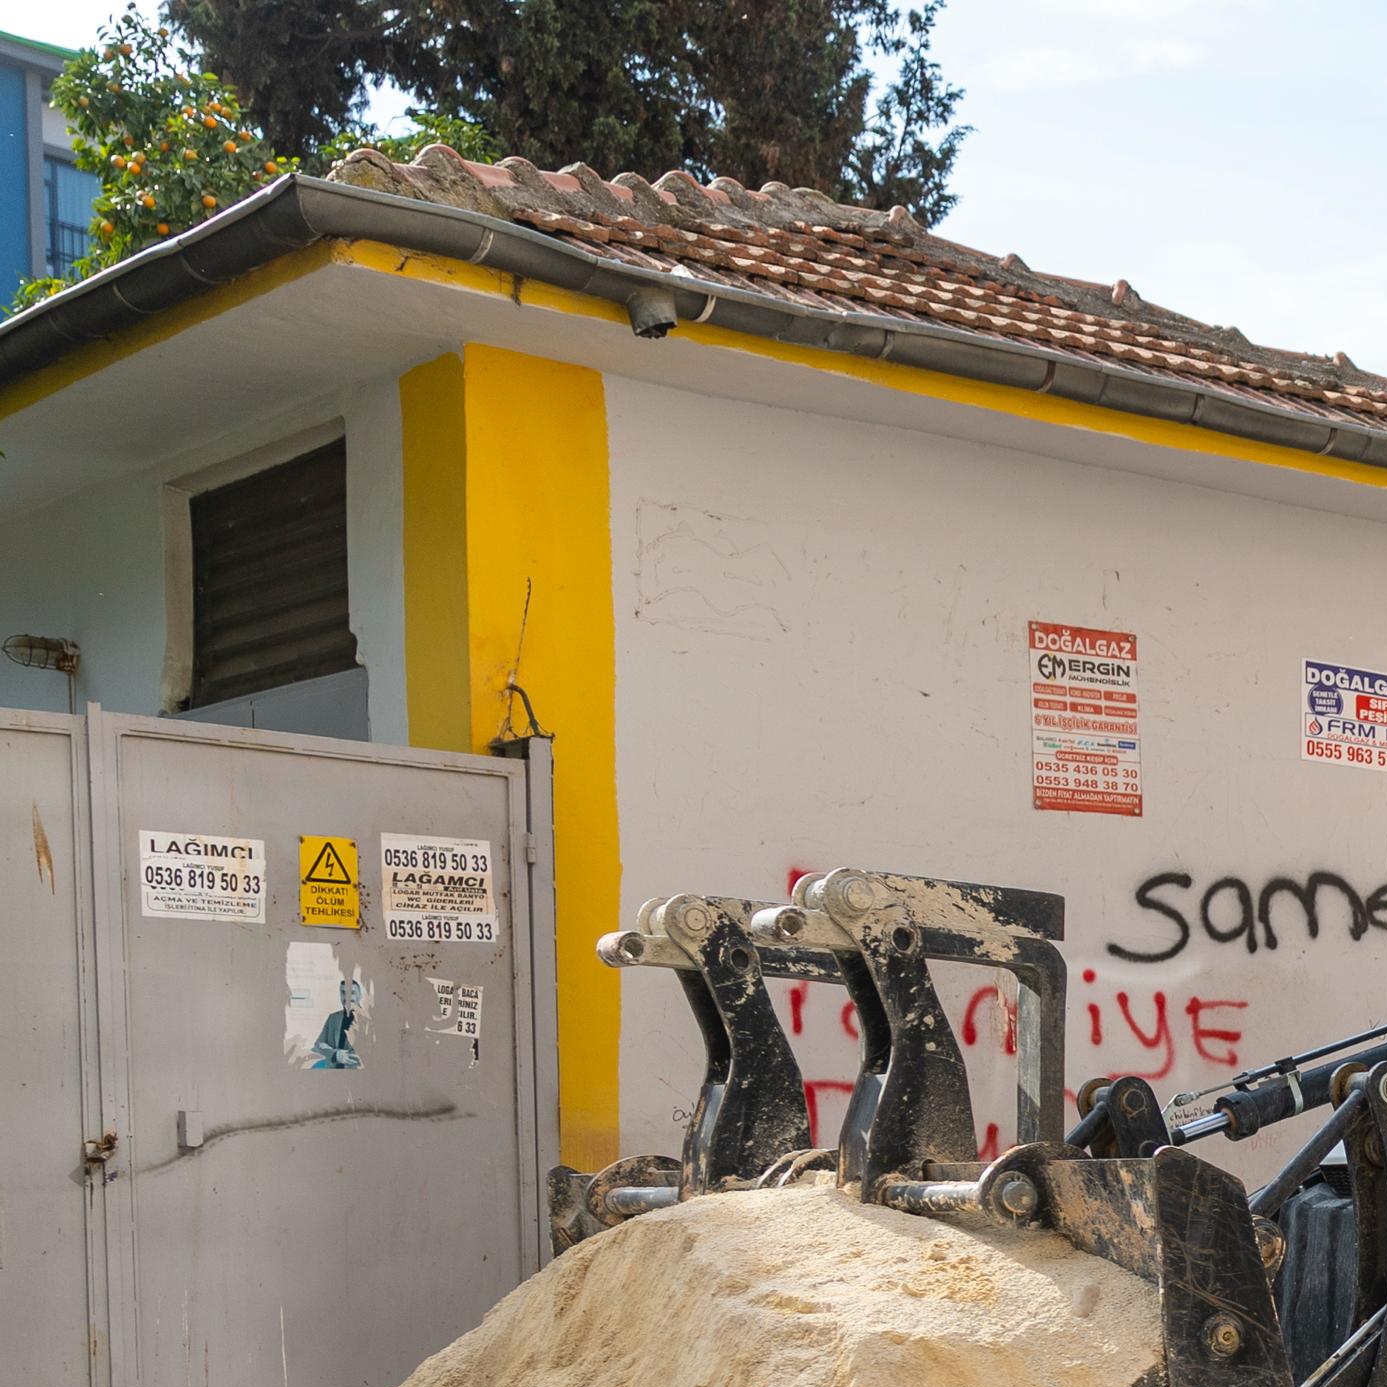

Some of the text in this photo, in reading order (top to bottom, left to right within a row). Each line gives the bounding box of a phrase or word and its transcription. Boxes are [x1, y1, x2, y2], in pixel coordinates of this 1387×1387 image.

[1034, 629, 1132, 659] DOĞALGAZ
[1327, 719, 1376, 739] FRM
[1307, 739, 1342, 759] 0555
[1347, 746, 1373, 764] 963
[1036, 760, 1138, 779] 0535 436 05 30
[1036, 774, 1138, 792] 0553 948 38 70
[150, 838, 253, 860] LAĞIMCI
[384, 848, 488, 873] 0536 819 50 33
[145, 865, 183, 887] 0536
[188, 869, 215, 890] 819
[220, 873, 238, 892] 50
[243, 875, 261, 895] 33
[392, 870, 485, 888] LAĞAMCI
[422, 890, 455, 898] MUTFAK
[426, 897, 474, 906] GİDERLERİ
[305, 906, 355, 918] TEHLİKESİ
[389, 919, 493, 941] 0536 819 50 33
[437, 983, 479, 999] LOGA BACA
[465, 1022, 476, 1034] 33
